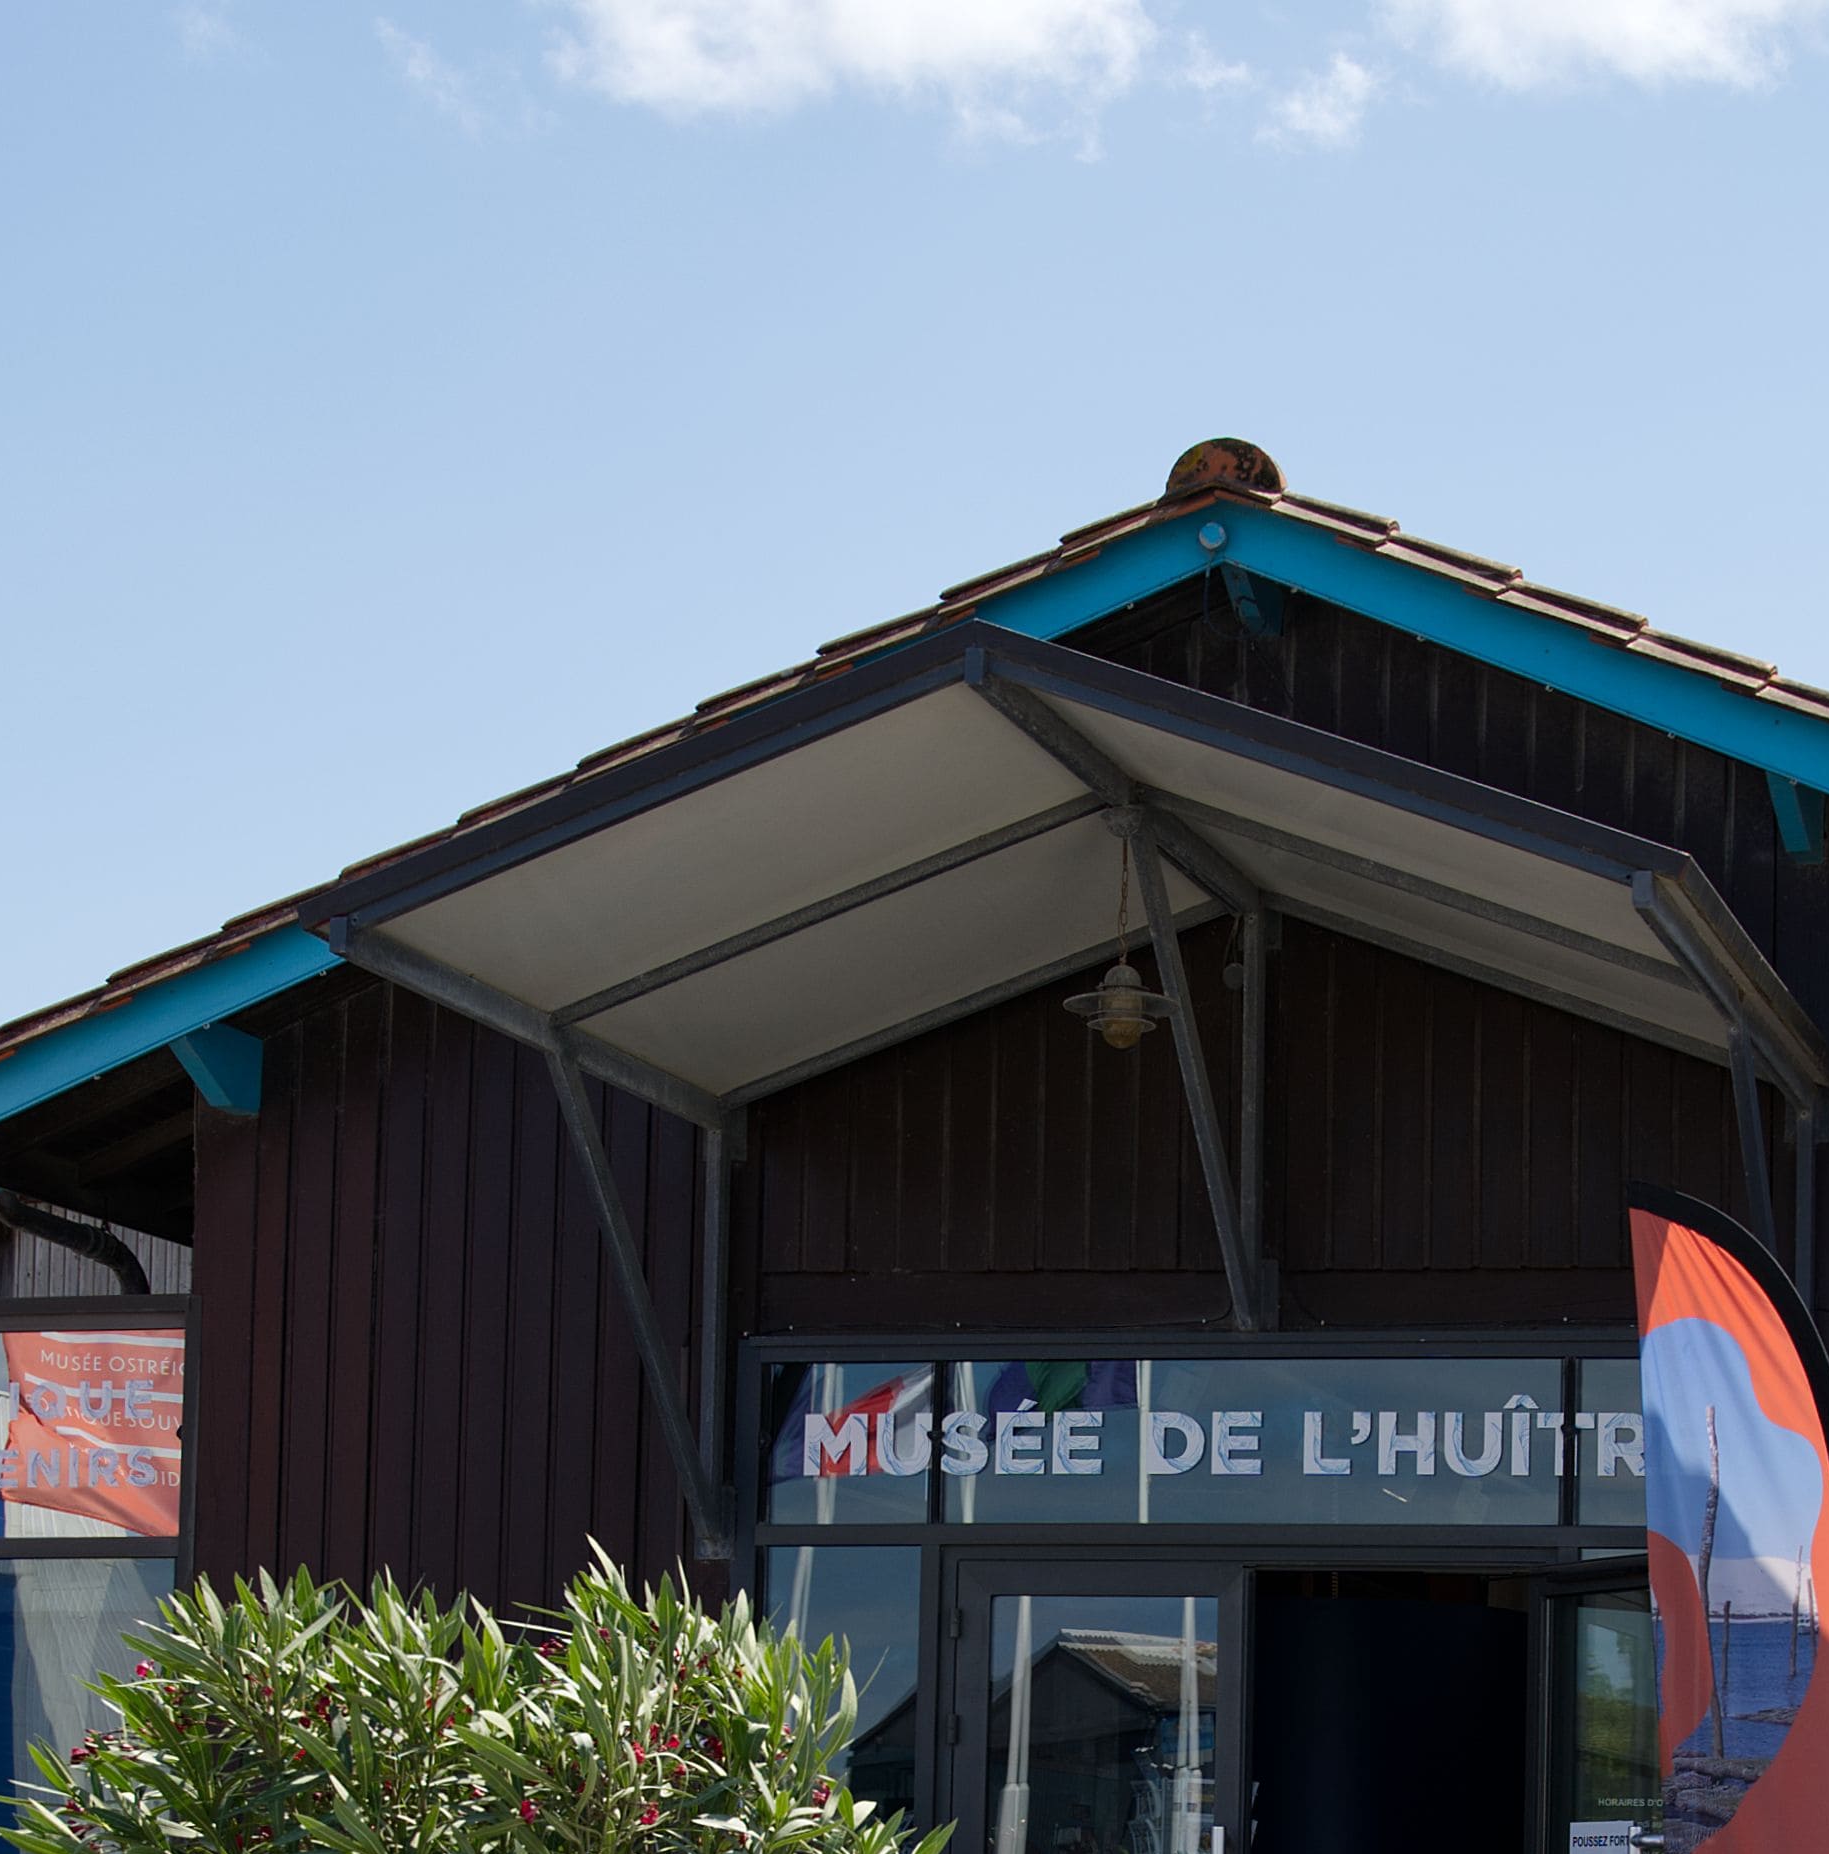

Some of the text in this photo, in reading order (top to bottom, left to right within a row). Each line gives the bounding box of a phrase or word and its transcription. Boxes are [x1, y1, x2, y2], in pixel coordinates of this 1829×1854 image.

[40, 1349, 103, 1373] MUSÉE
[802, 1397, 1104, 1476] MUSÉE
[1149, 1411, 1263, 1476] DE
[1597, 1797, 1646, 1808] HORAIRES
[1572, 1834, 1630, 1848] POUSSEZ FORT
